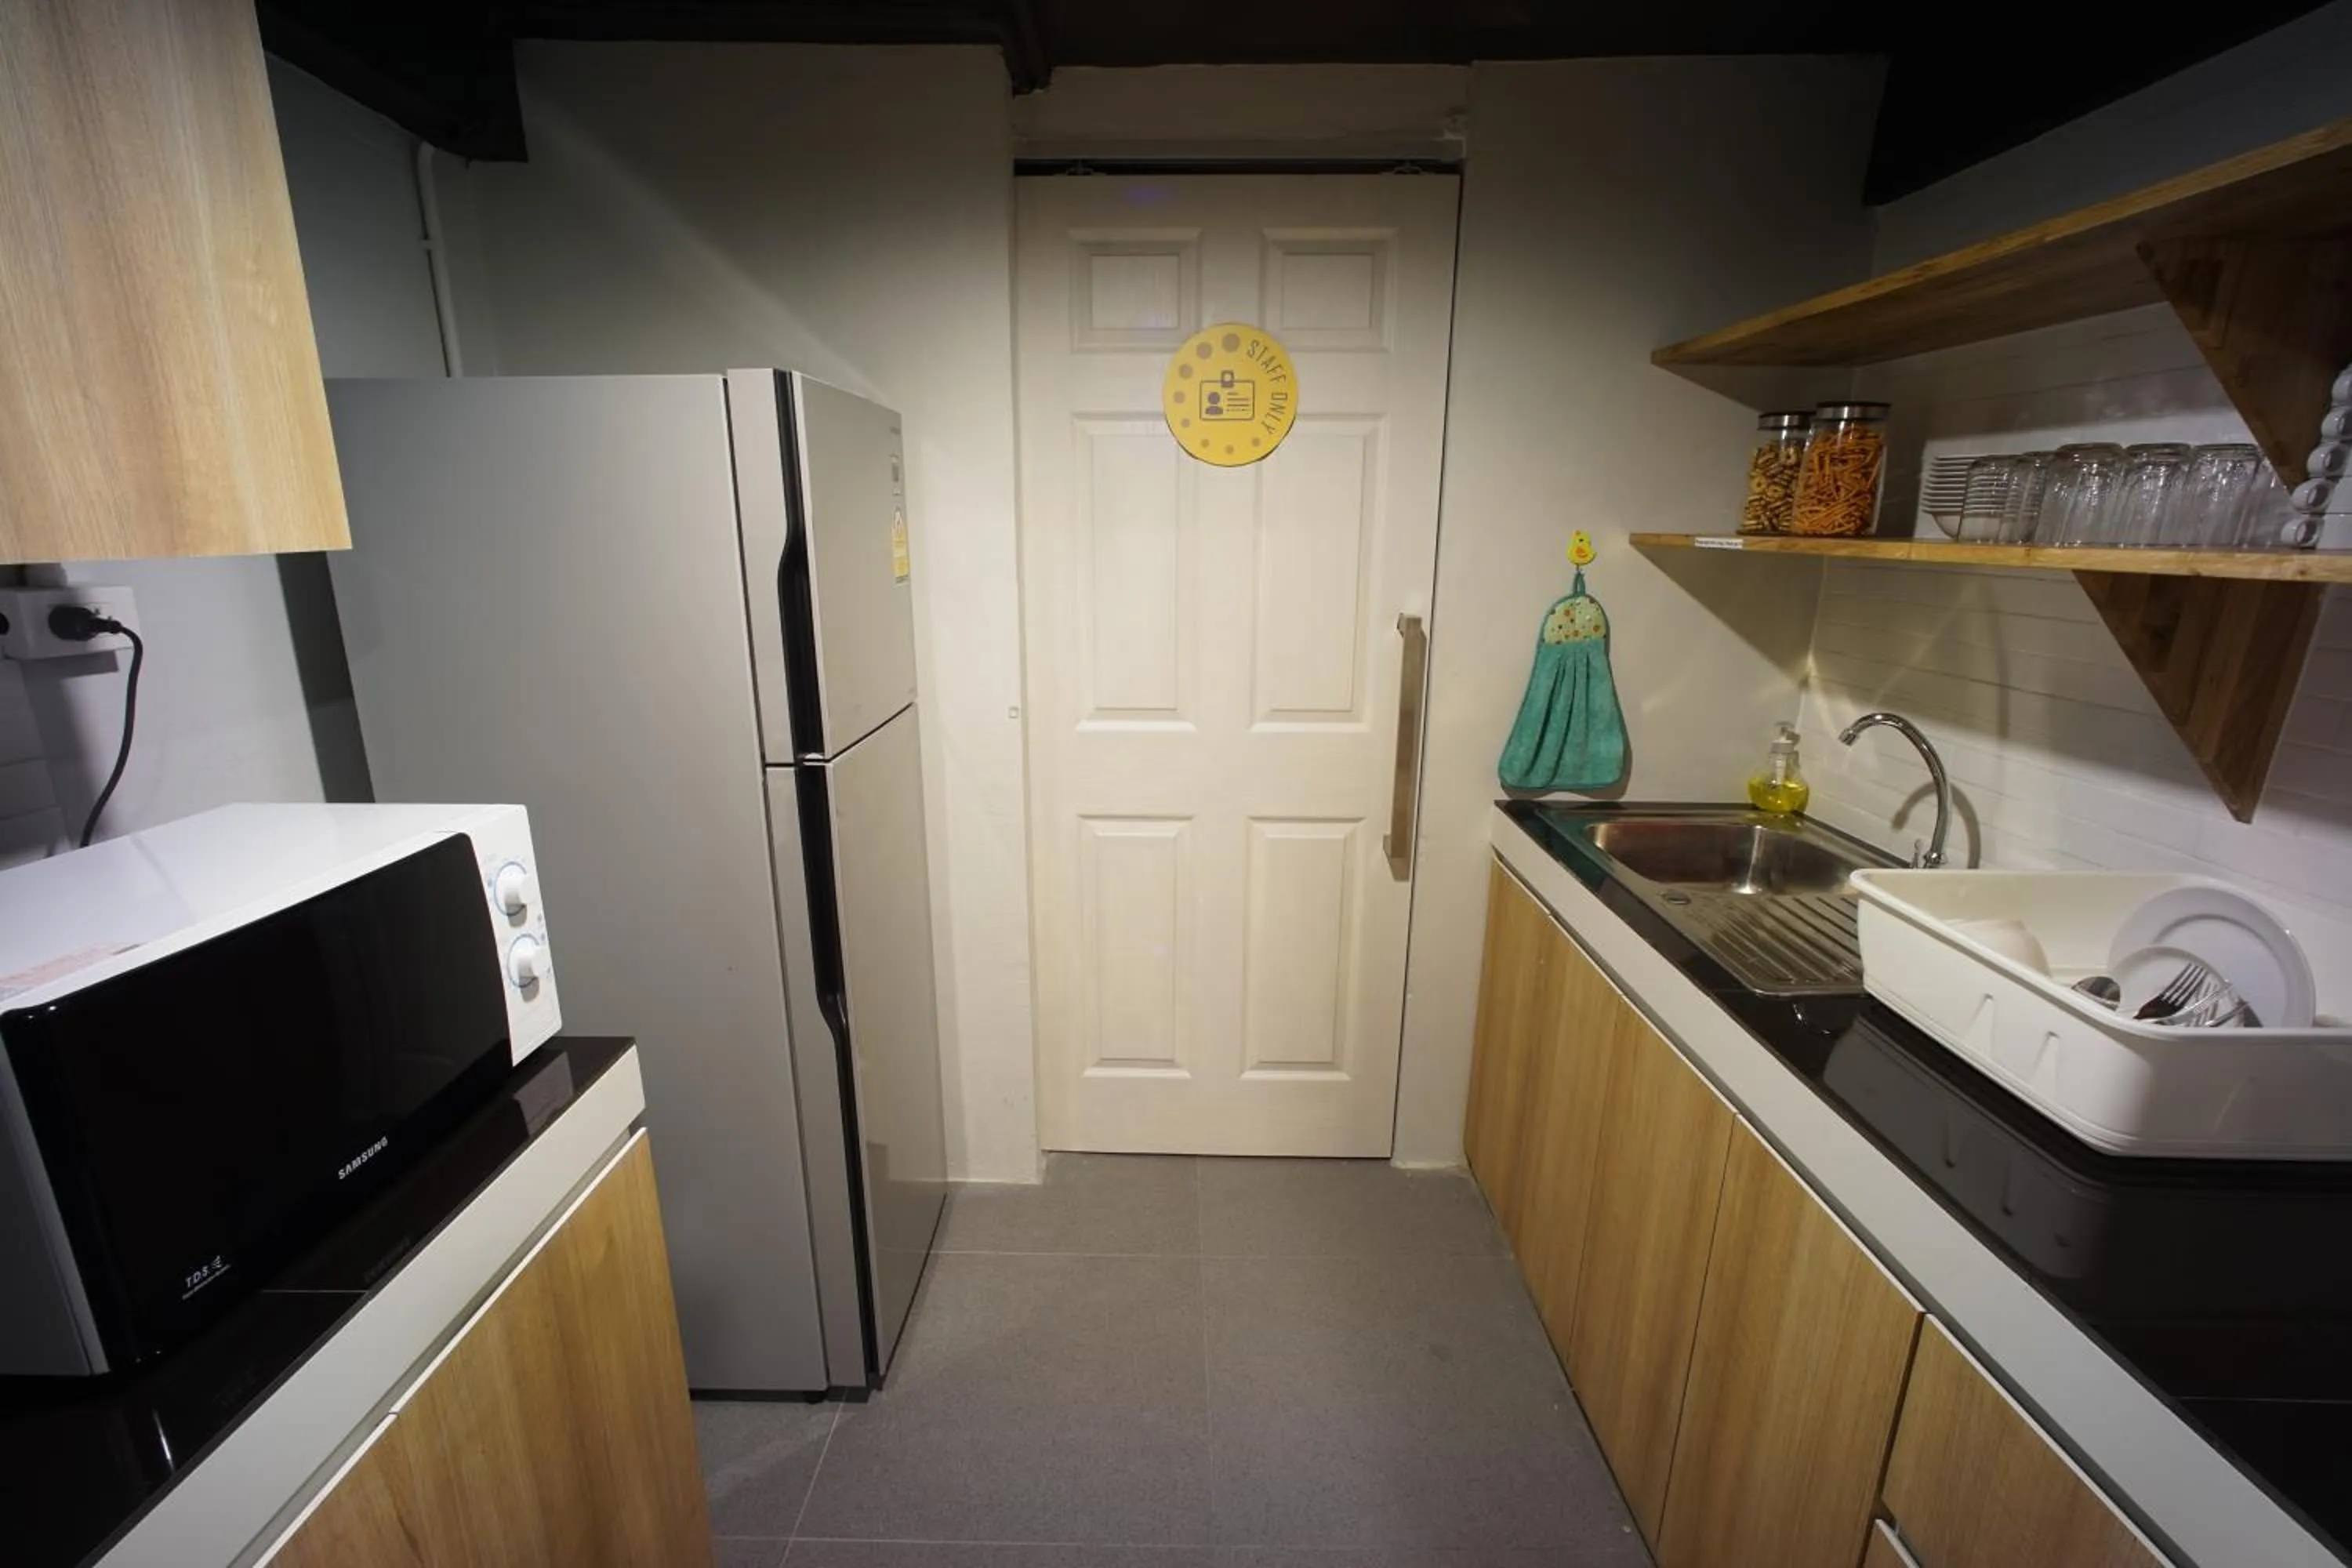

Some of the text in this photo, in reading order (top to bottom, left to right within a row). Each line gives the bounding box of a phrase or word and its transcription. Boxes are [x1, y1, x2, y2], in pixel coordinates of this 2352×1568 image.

[1247, 339, 1288, 434] STAFF ONLY
[338, 1136, 388, 1180] SAMSUNG
